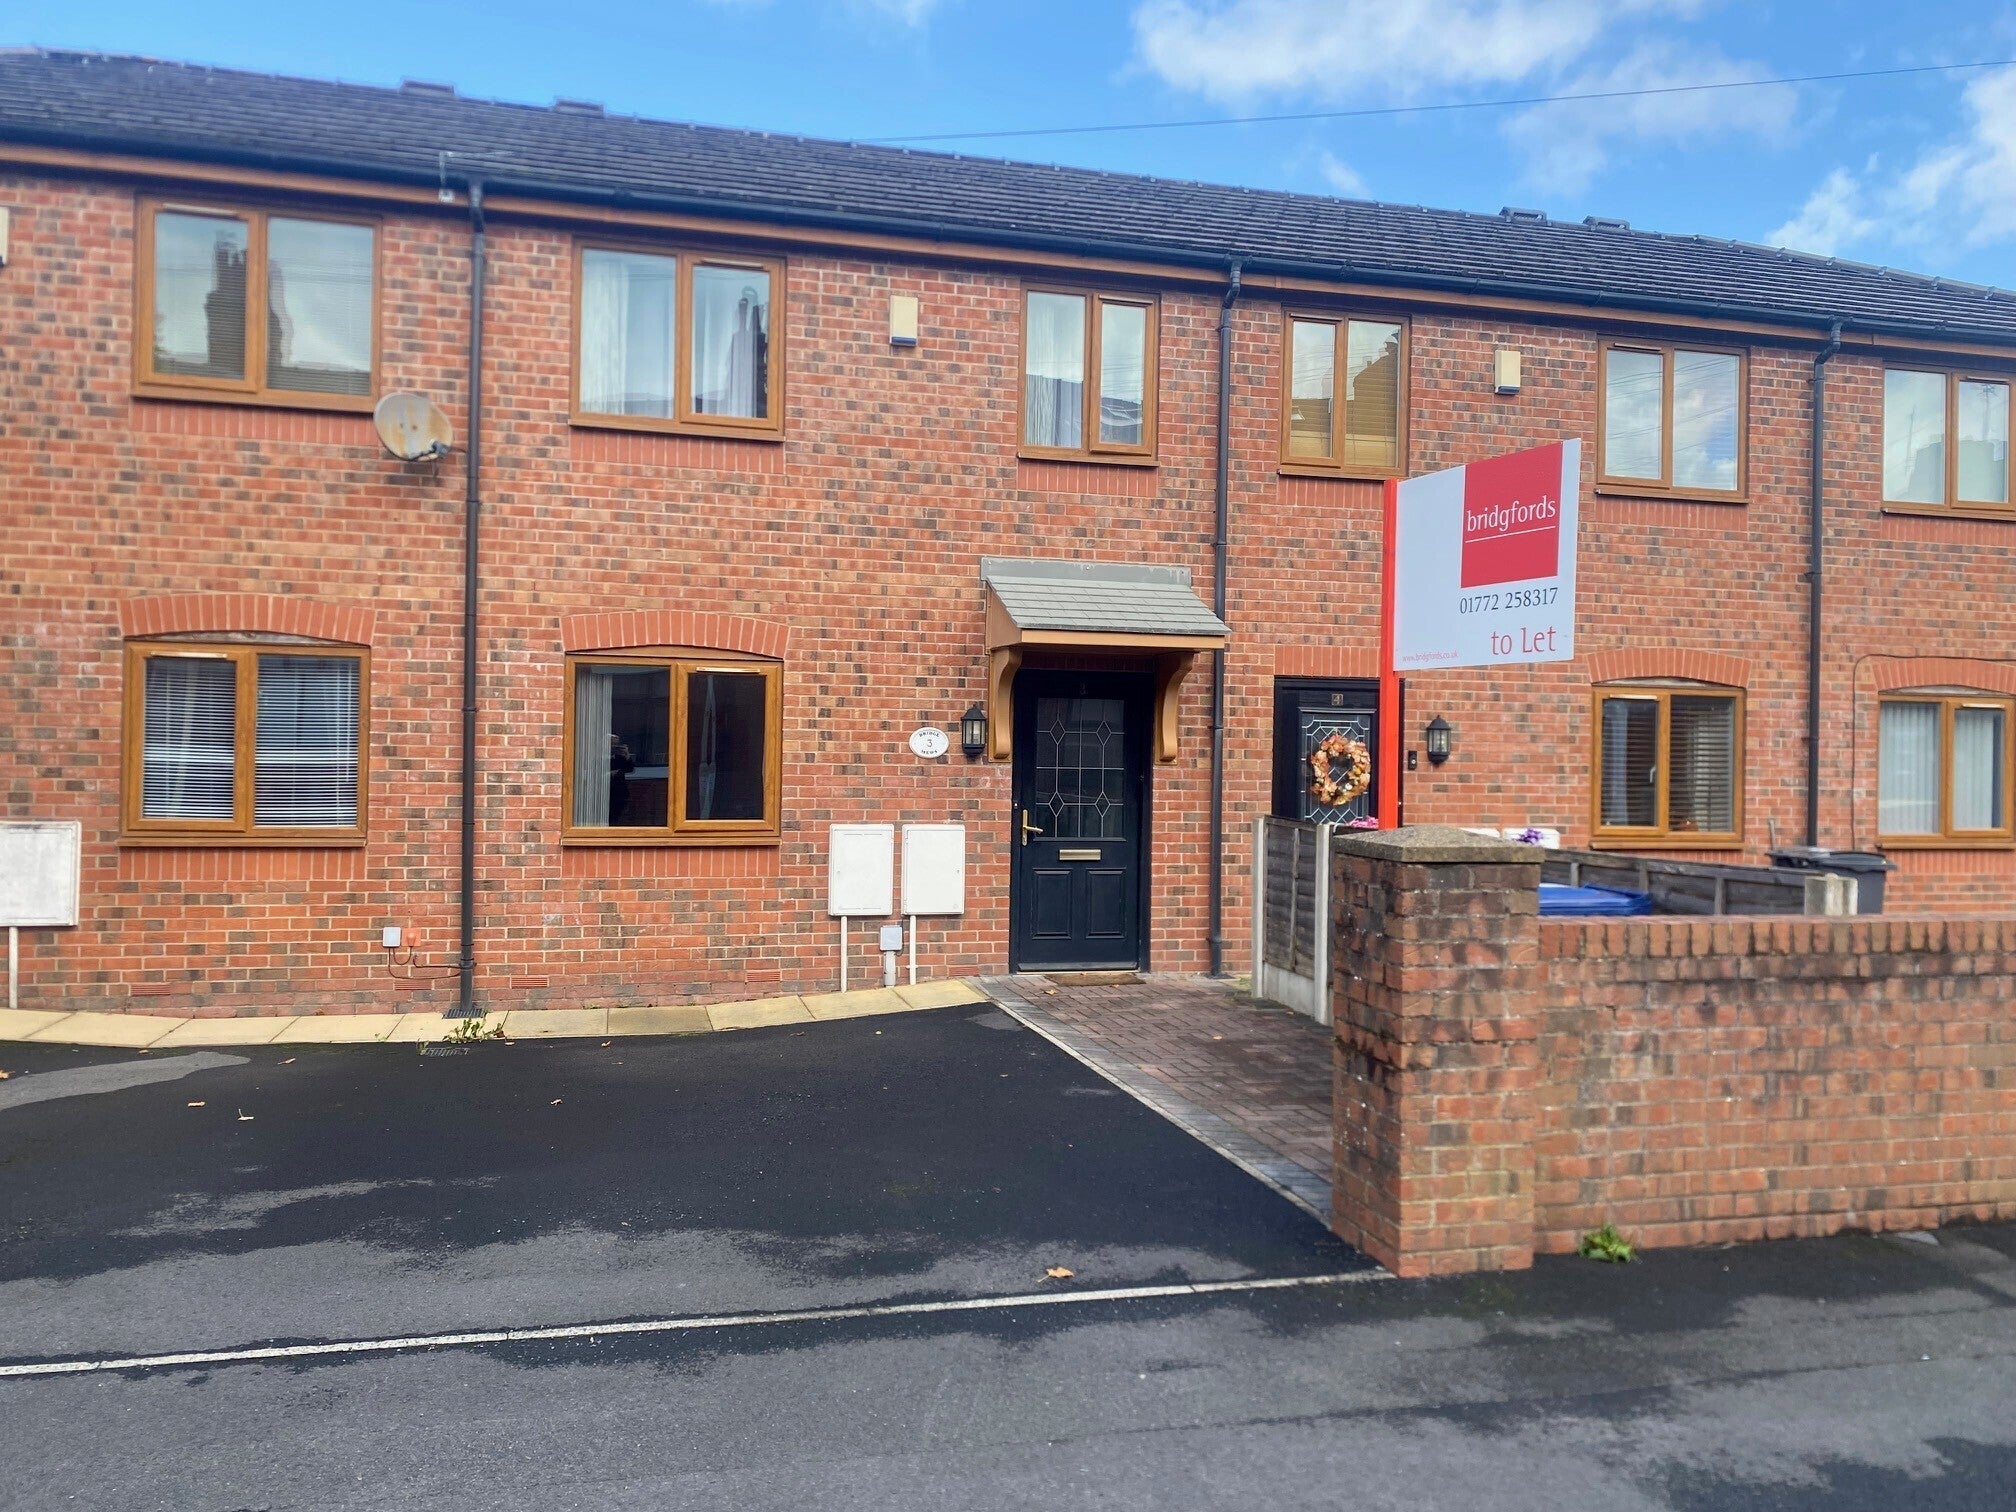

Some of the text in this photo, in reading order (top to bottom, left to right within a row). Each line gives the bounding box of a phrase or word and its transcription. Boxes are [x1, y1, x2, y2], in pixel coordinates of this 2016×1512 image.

[1467, 495, 1556, 532] bridgfords
[1460, 588, 1558, 614] 01772 258317
[1491, 626, 1556, 655] to Let
[926, 739, 933, 748] 3
